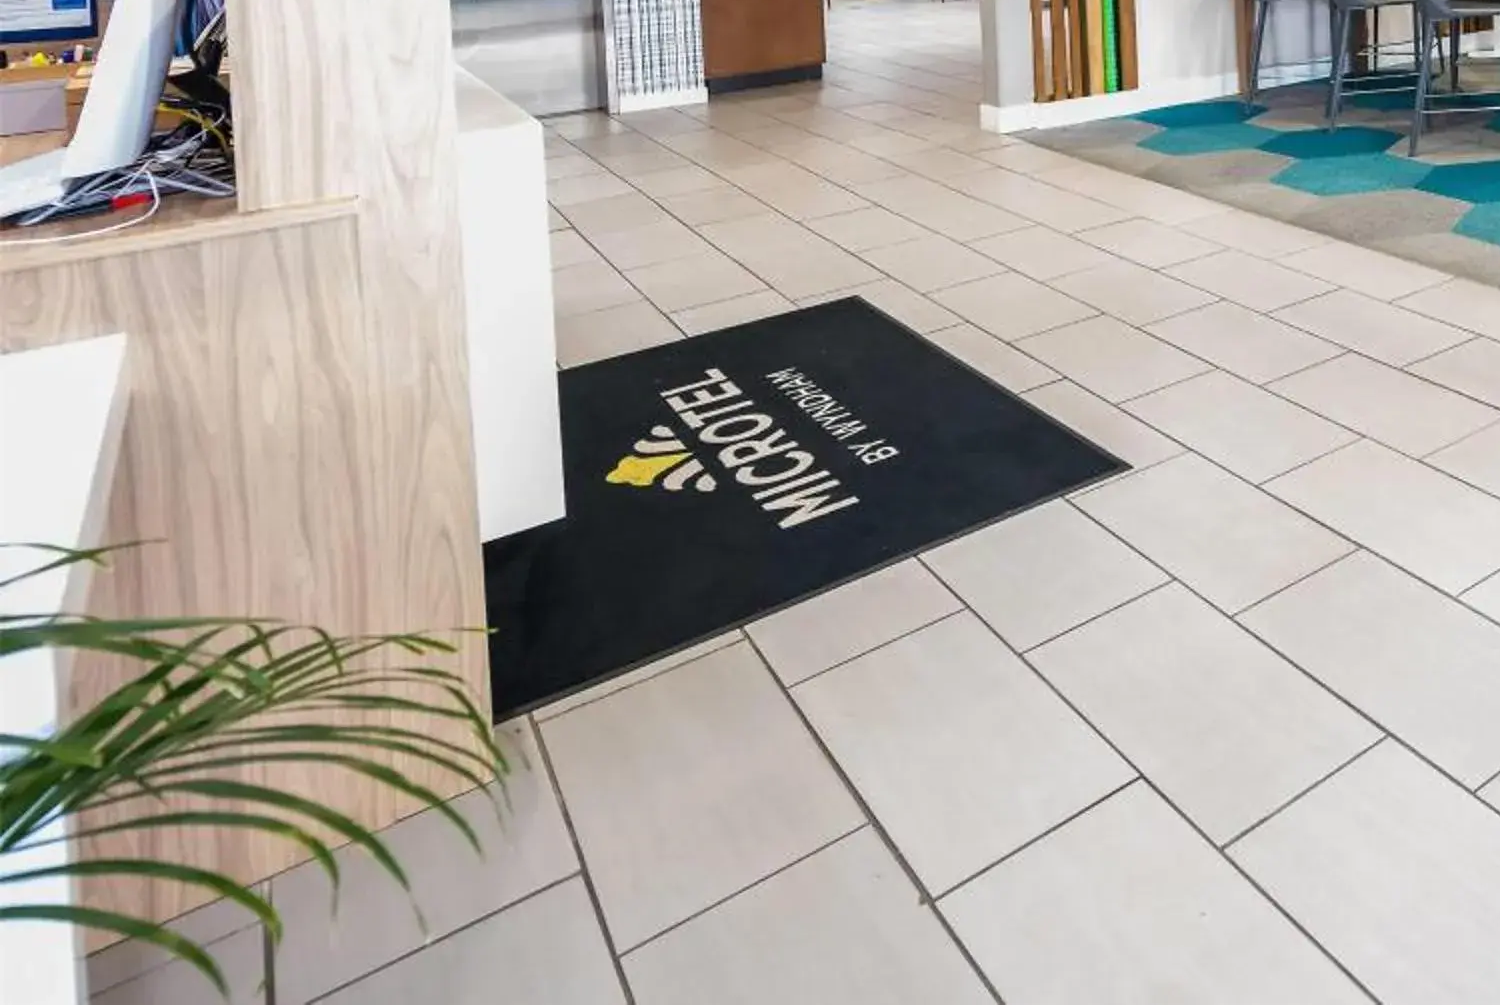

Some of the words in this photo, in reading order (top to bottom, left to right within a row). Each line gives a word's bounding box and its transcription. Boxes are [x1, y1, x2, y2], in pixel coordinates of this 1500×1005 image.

[765, 366, 868, 440] WYNDHAM
[660, 367, 860, 530] MICROTEL
[845, 439, 900, 466] BY
